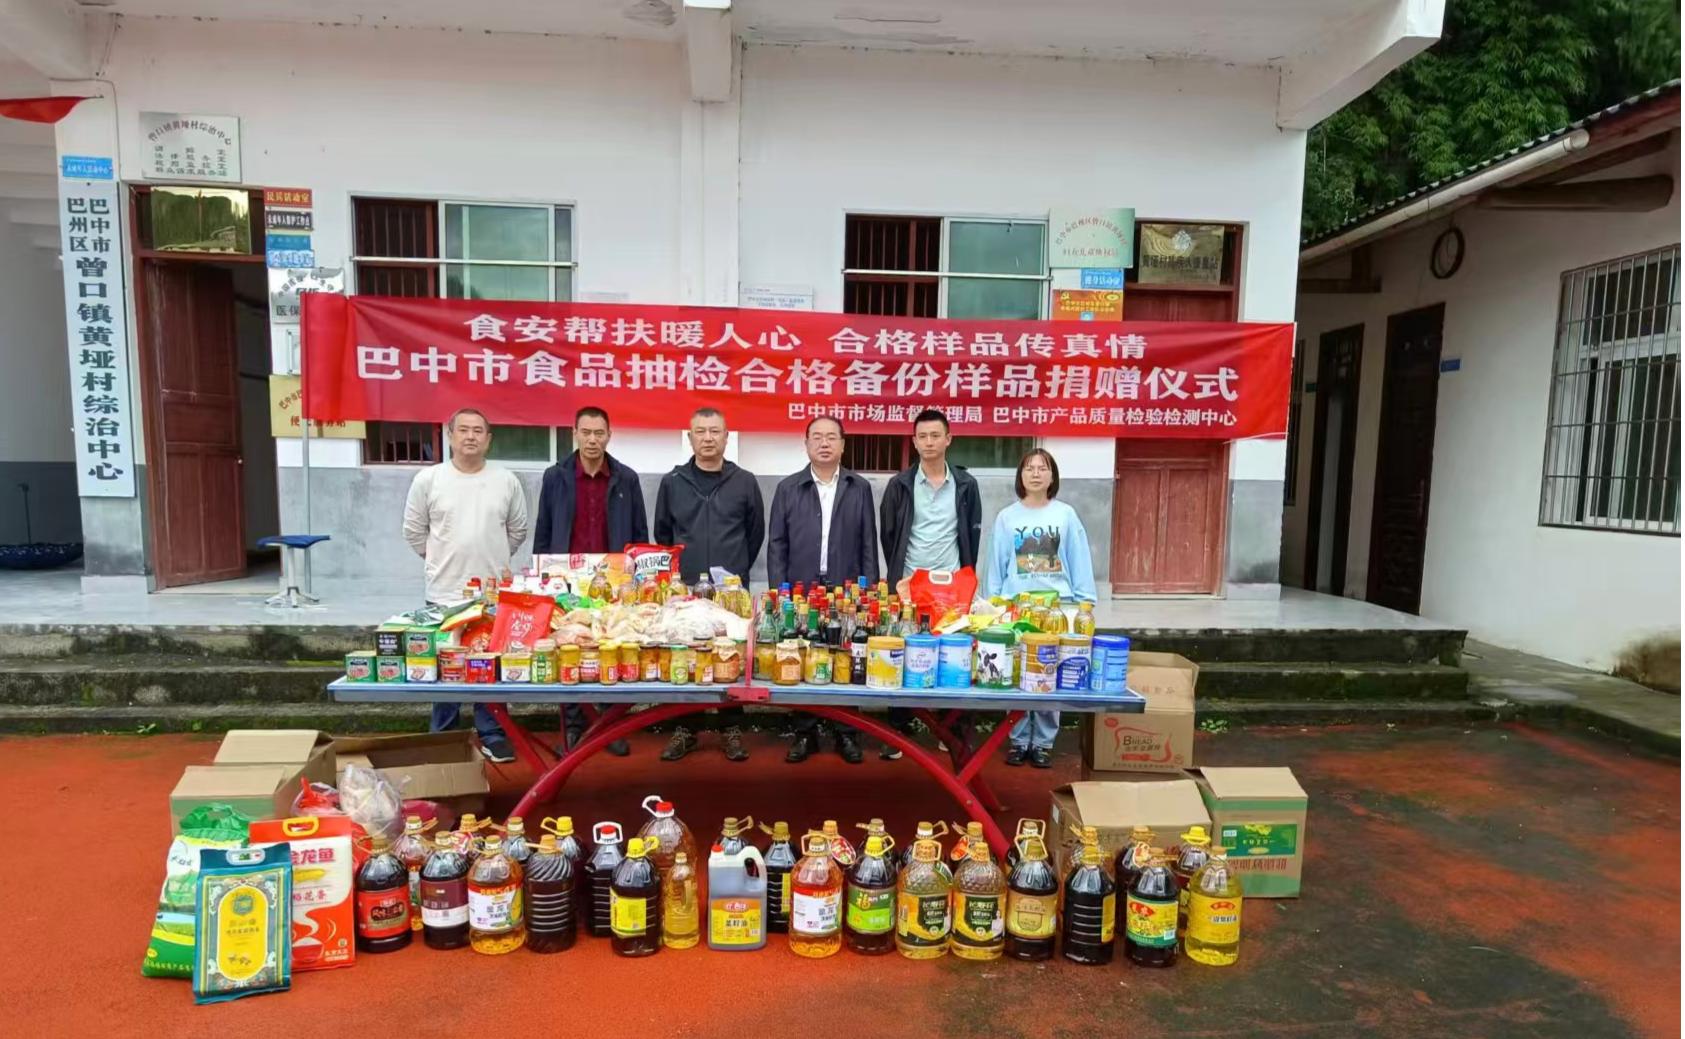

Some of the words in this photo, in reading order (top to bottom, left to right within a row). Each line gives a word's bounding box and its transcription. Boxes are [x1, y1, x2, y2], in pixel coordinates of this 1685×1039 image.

[67, 197, 89, 253] 巴州区
[89, 198, 111, 254] 巴中市
[463, 313, 802, 356] 食安帮扶暖人心
[827, 327, 1149, 361] 合格样品传真情
[75, 256, 124, 481] 曾口镇黄垭村综治中心
[356, 345, 1241, 403] 巴中市食品抽检合格备份样品捐赠仪式
[787, 402, 983, 425] 巴中市市场监督理局
[993, 406, 1239, 428] 巴中市产品质量检验检测中心
[1015, 525, 1060, 540] YOU
